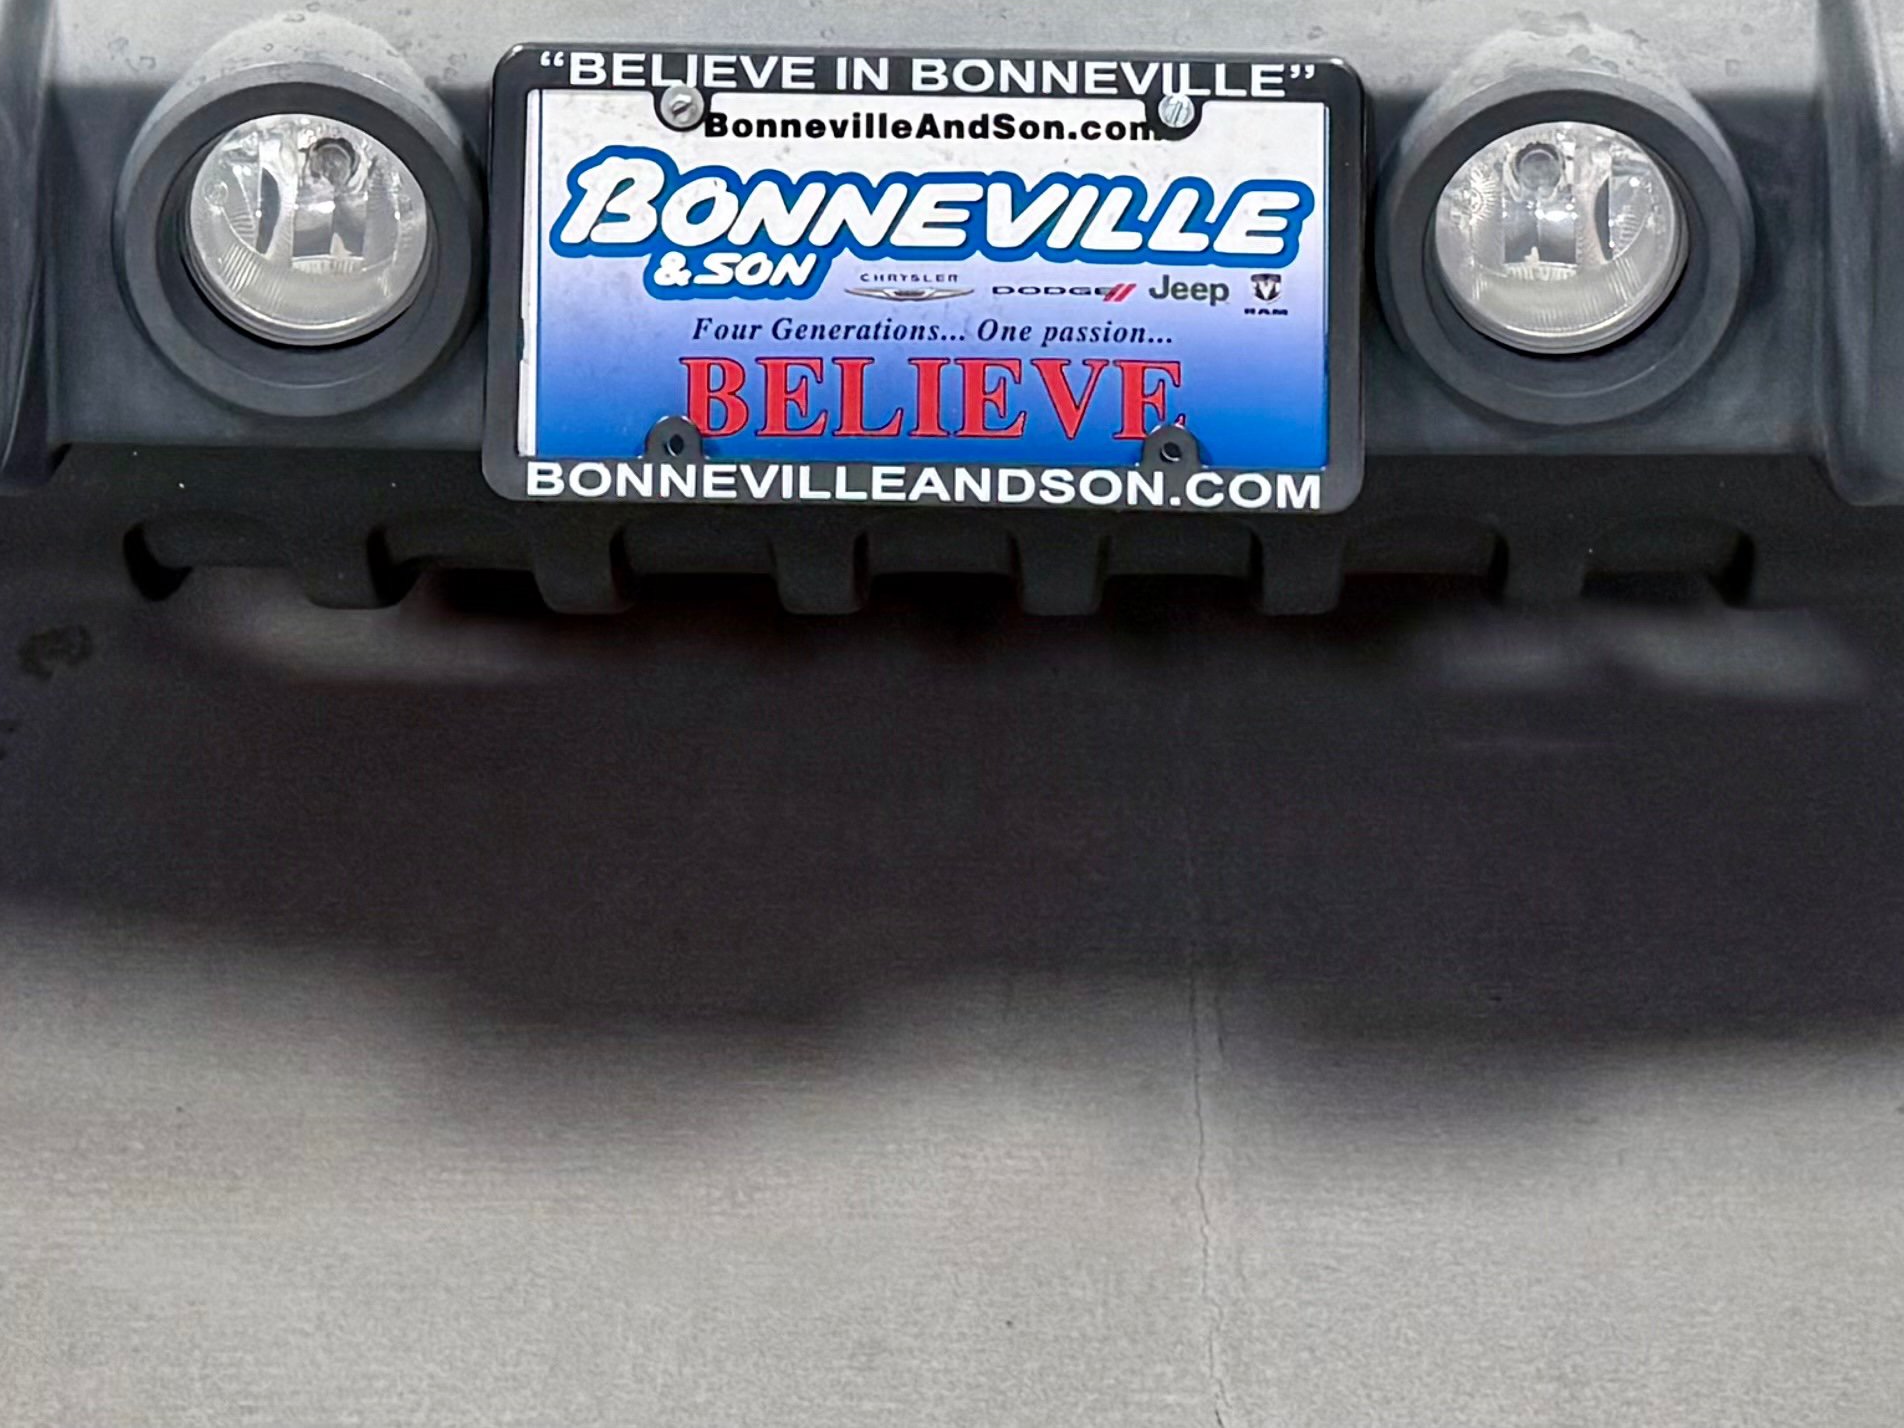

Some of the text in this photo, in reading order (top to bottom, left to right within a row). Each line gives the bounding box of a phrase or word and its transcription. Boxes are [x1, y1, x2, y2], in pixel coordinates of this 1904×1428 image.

[836, 56, 889, 92] IN
[703, 110, 1163, 142] BonnevilleAndSon.com
[559, 155, 1300, 255] BONNEVILLE
[859, 272, 958, 283] CHRYSLER
[1148, 274, 1230, 306] Jeep
[691, 316, 1173, 348] Four Generations... One passion...
[678, 355, 1187, 440] BELIEVE
[526, 460, 1321, 510] BONNEVILLEANDSON.COM
